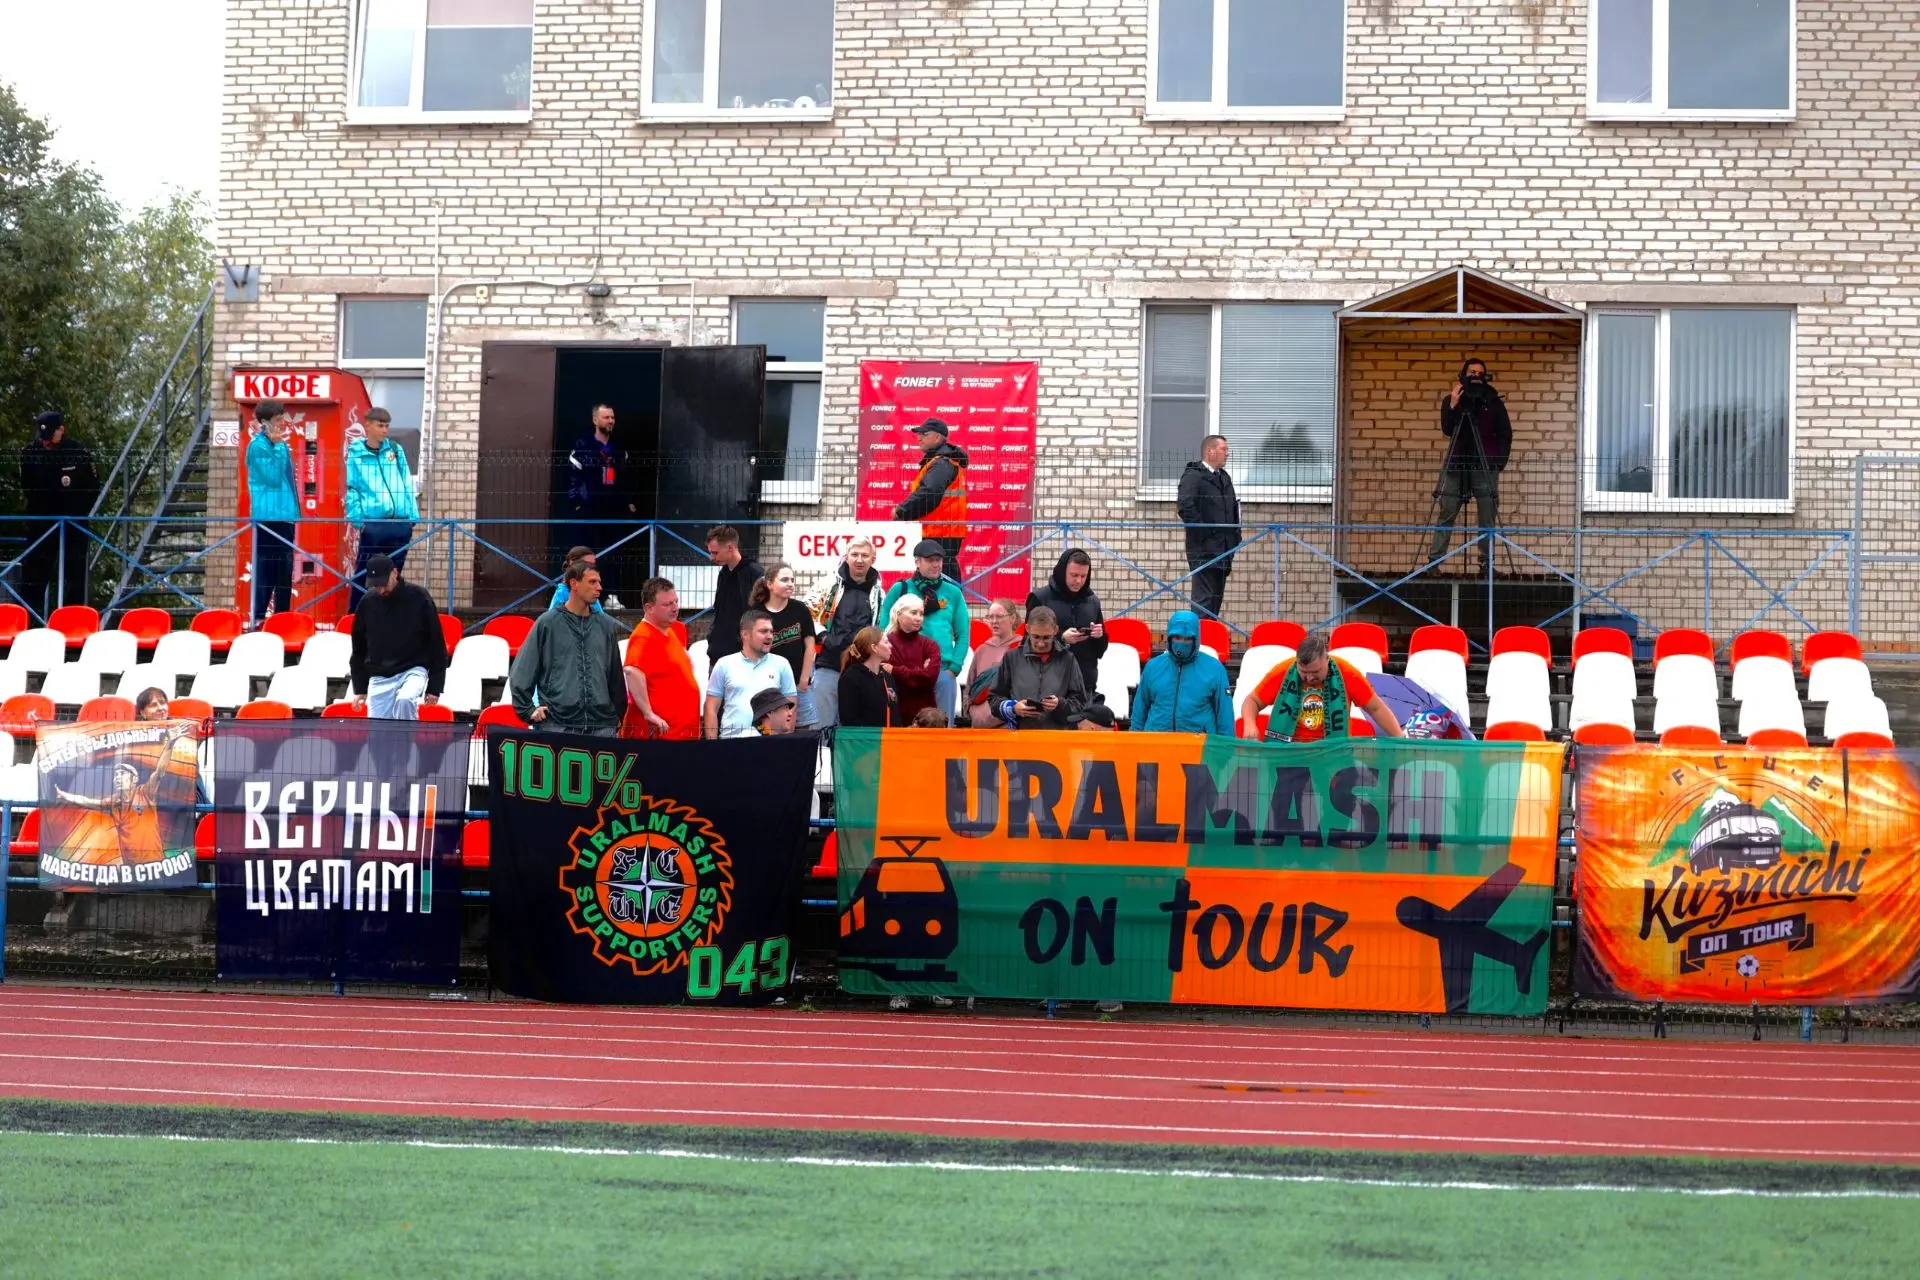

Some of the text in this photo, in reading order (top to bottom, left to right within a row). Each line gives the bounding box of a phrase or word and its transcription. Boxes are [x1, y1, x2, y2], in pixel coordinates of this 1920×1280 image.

[244, 375, 321, 397] КОФЕ
[893, 377, 942, 388] FONBET
[799, 535, 906, 557] СЕКТР 2
[499, 739, 642, 809] 100%
[943, 758, 1444, 852] URALMASH
[244, 781, 420, 851] ВЕРНЫ
[577, 813, 716, 874] URALMASH
[40, 851, 193, 885] НАВСЕГДА В СТРОЮ!
[245, 859, 414, 916] ЦВЕТАМ
[1638, 840, 1872, 943] Kuzmichi
[576, 885, 717, 959] SUPPORTERS
[1018, 896, 1118, 966] ON
[1739, 919, 1794, 946] TOUR
[686, 935, 791, 999] 043
